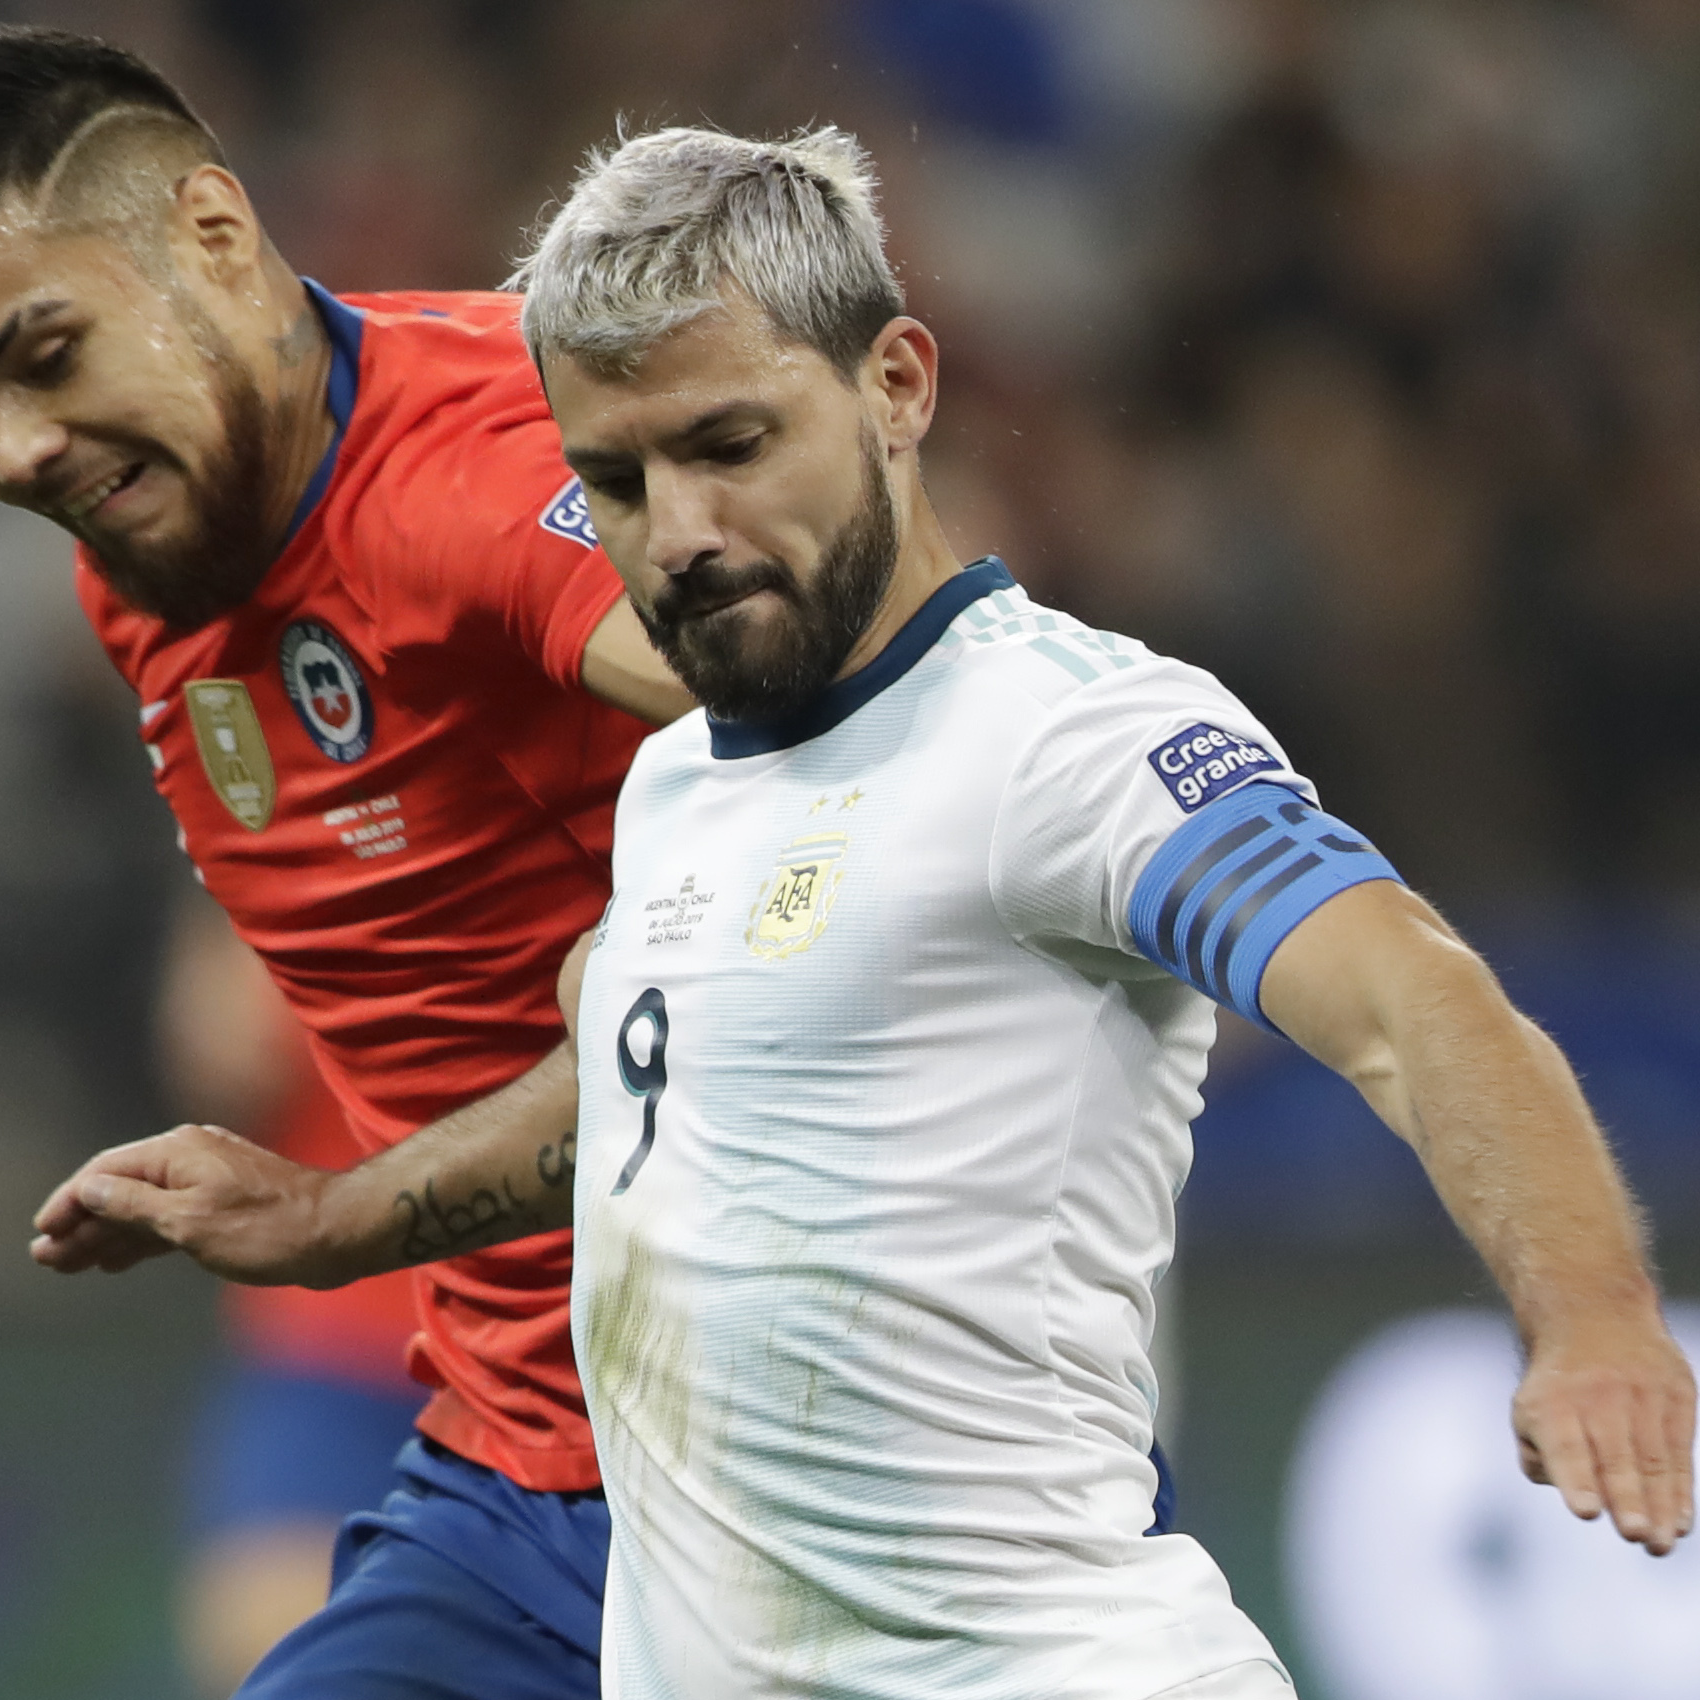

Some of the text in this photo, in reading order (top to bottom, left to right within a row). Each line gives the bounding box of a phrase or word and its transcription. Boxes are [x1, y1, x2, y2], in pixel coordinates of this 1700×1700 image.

[1158, 729, 1229, 775] Cree
[691, 892, 716, 905] CHILE
[765, 865, 819, 924] AFA
[664, 928, 692, 943] PAULO
[609, 987, 670, 1197] 9
